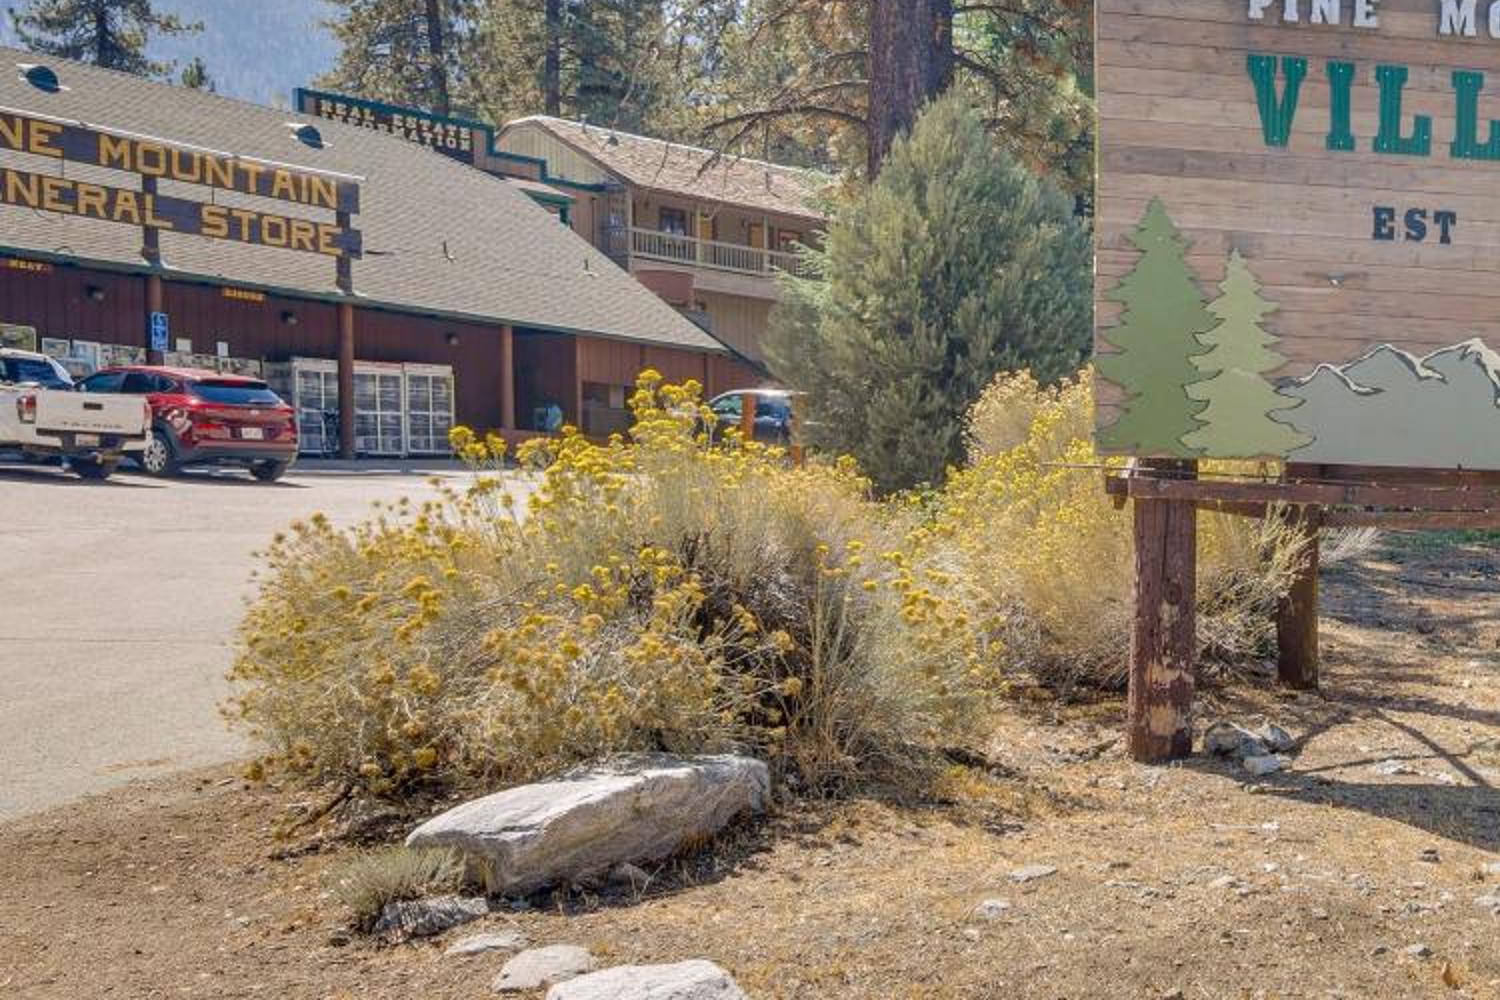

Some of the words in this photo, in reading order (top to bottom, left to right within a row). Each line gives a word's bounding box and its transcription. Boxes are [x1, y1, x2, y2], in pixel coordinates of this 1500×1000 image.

[319, 99, 375, 122] REAL
[392, 113, 471, 139] ESTATE
[0, 117, 64, 157] NE
[97, 133, 337, 208] MOUNTAIN
[201, 206, 343, 256] STORE
[1371, 206, 1457, 245] EST
